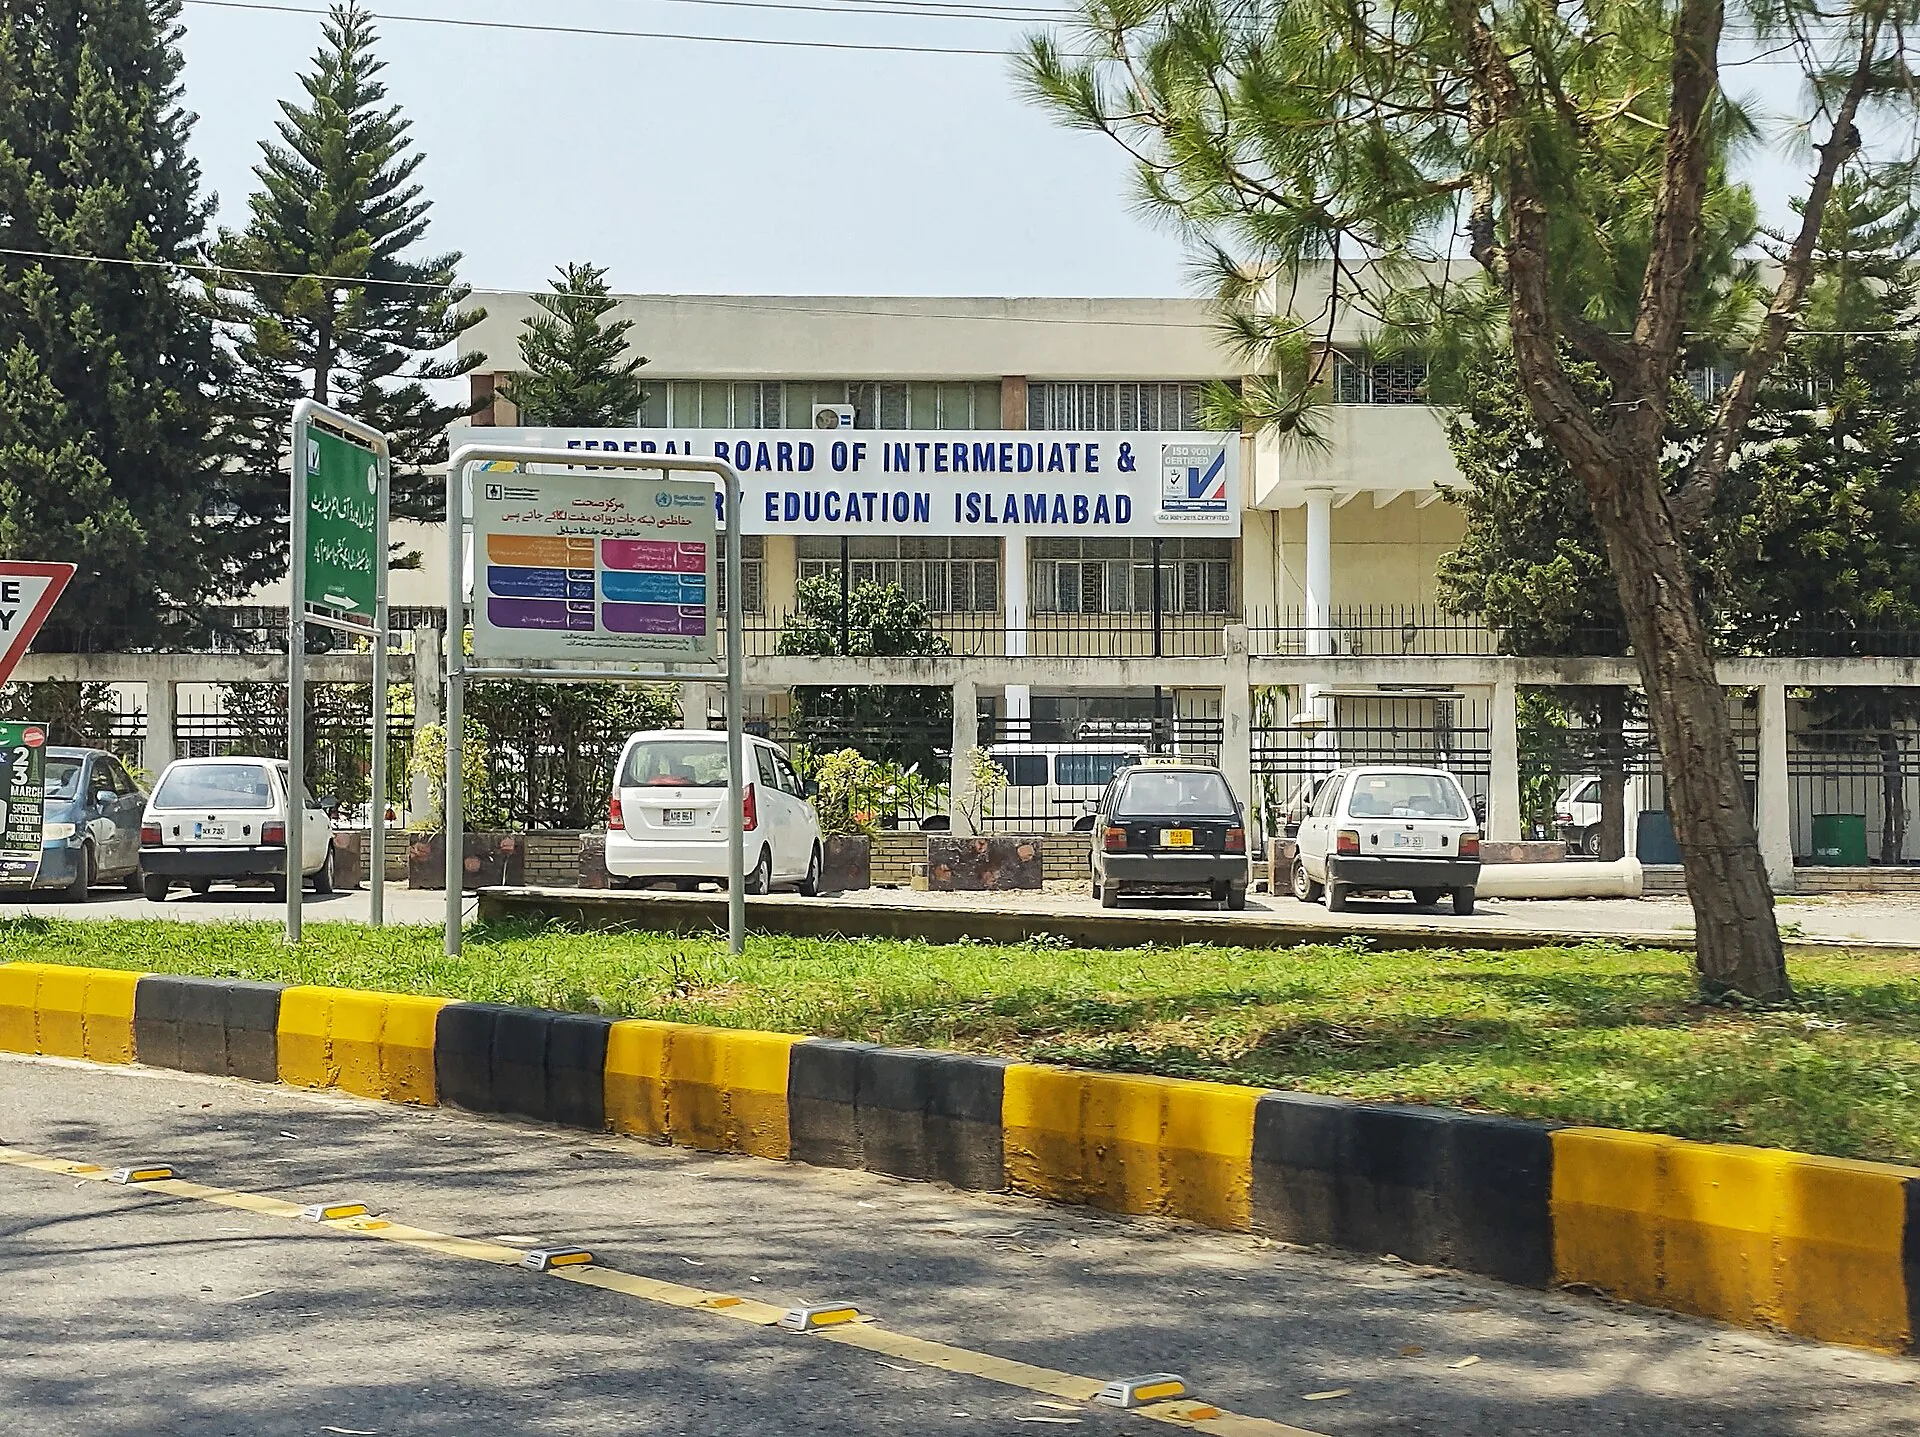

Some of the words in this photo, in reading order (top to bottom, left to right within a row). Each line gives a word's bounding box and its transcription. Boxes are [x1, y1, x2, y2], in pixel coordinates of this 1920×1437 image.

[1172, 447, 1189, 455] ISO
[714, 441, 814, 472] BOARD
[831, 442, 867, 472] OF
[883, 442, 1100, 473] INTERMEDIATE
[1117, 441, 1137, 473] &
[1165, 457, 1209, 465] CERTIFIED
[572, 499, 604, 507] صحت
[603, 497, 625, 512] مرکز
[765, 491, 931, 522] EDUCATION
[955, 492, 1132, 524] ISLAMABAD
[10, 785, 44, 798] MARCH
[12, 804, 40, 814] SPECIAL
[9, 814, 42, 825] DISCOUNT
[6, 831, 42, 843] PRODUCTS
